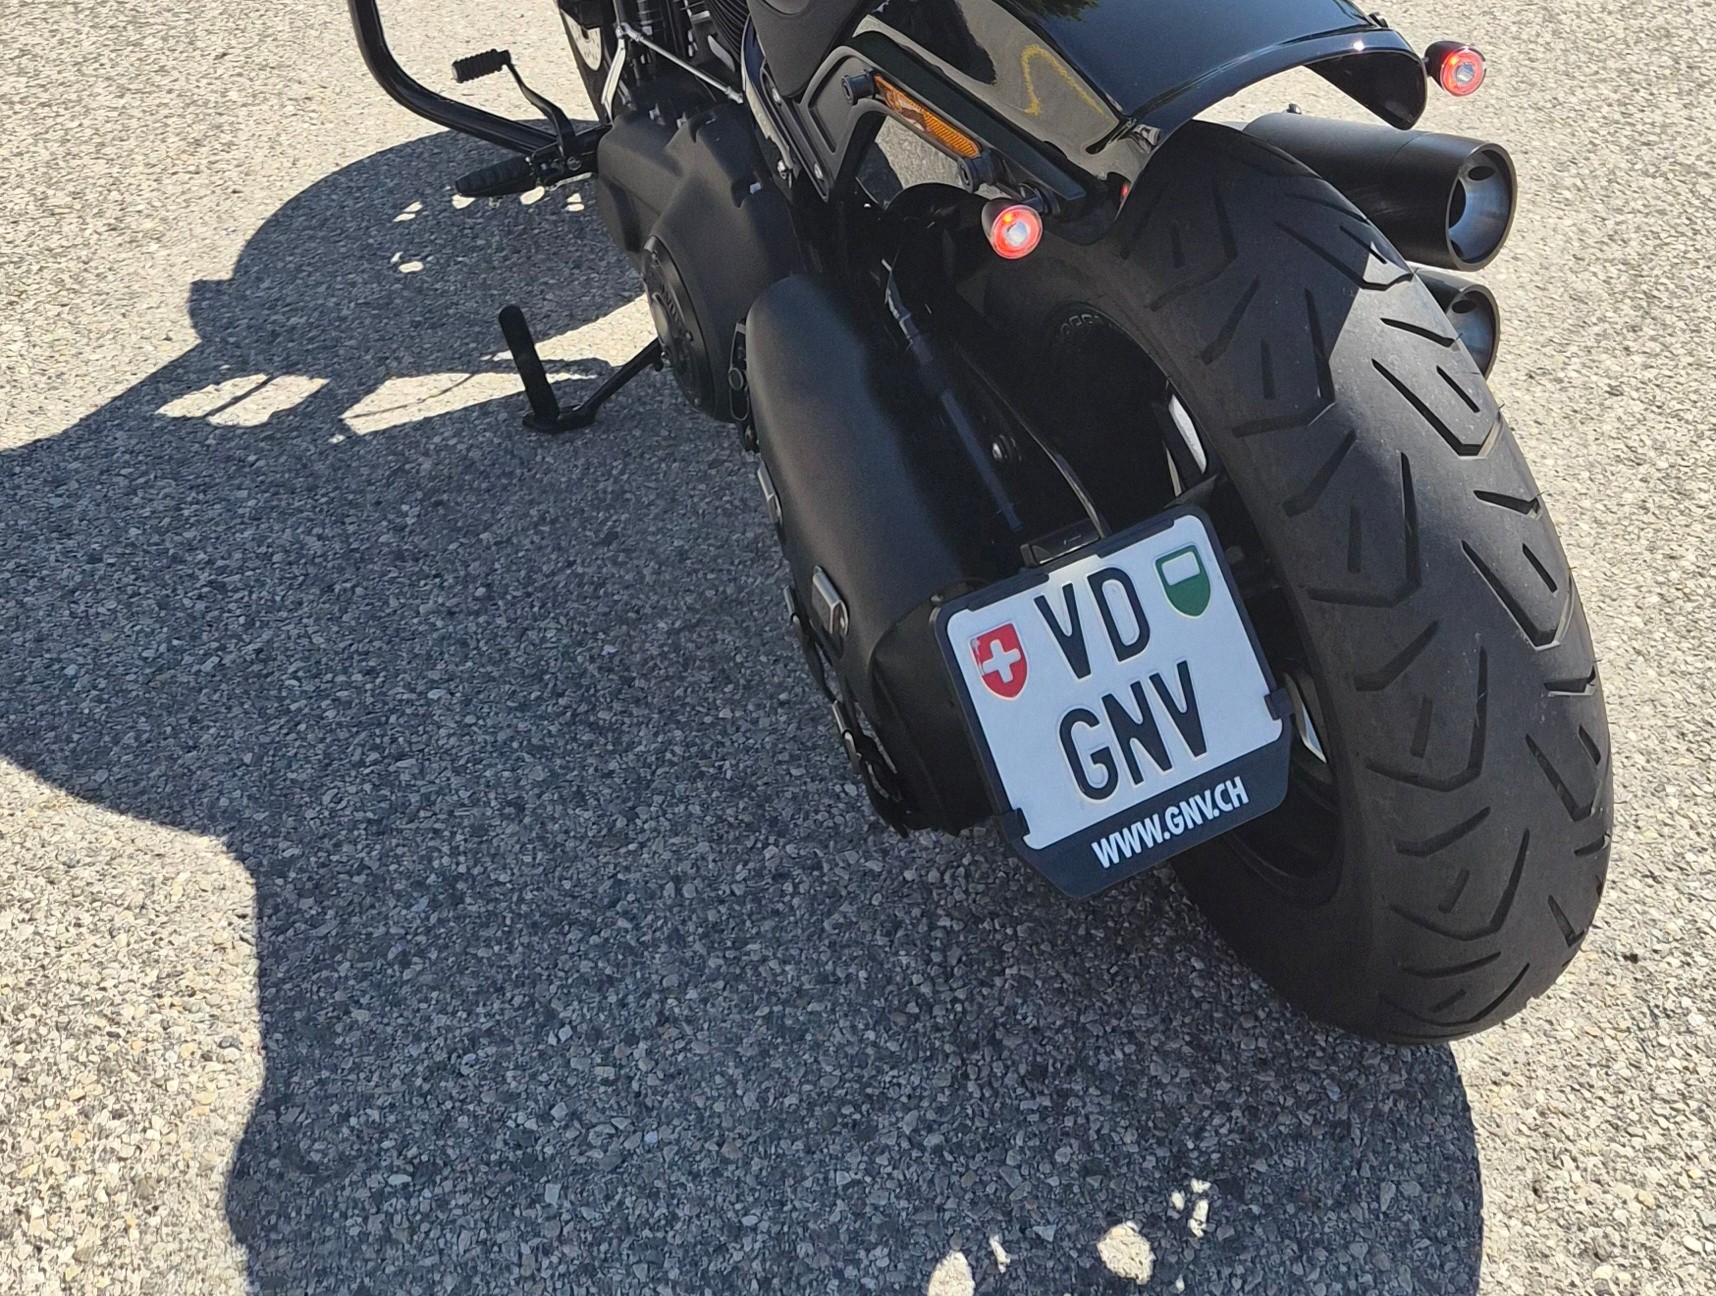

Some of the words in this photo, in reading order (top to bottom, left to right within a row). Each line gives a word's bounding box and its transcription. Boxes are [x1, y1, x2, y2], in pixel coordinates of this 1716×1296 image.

[1033, 566, 1151, 679] VD
[1059, 660, 1207, 800] GNV
[1091, 776, 1250, 869] WWW.GNV.CH
